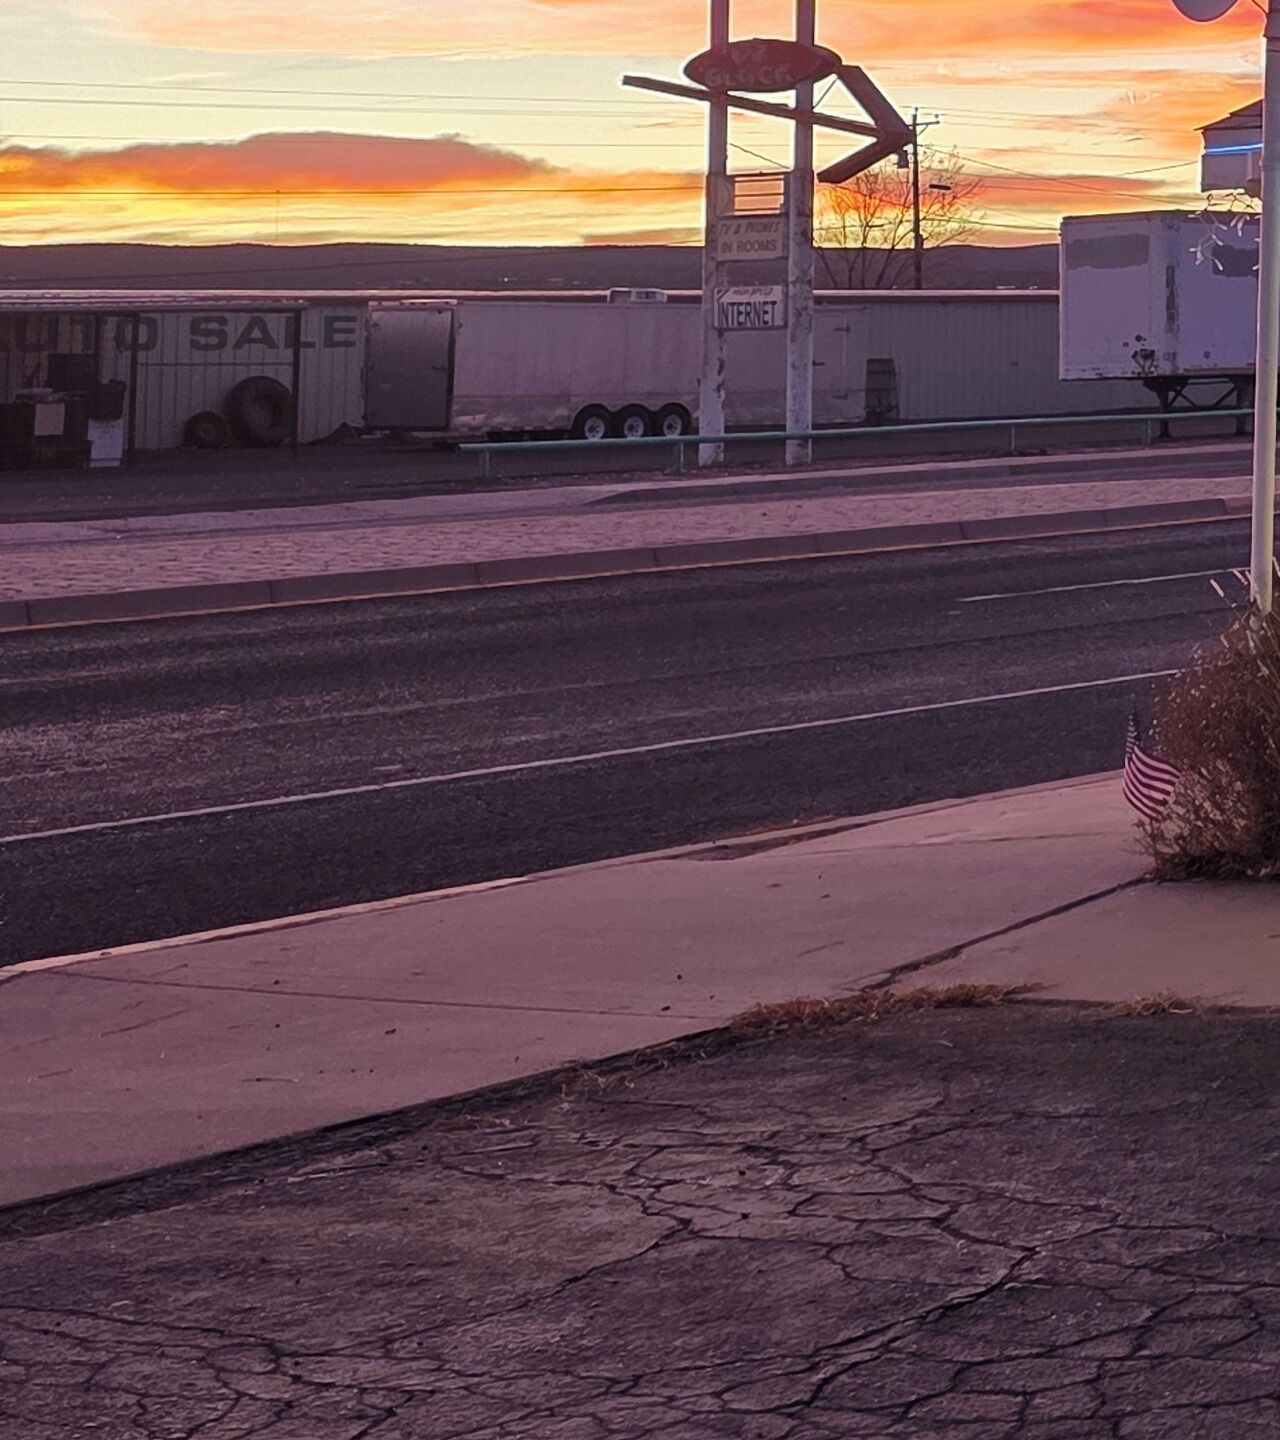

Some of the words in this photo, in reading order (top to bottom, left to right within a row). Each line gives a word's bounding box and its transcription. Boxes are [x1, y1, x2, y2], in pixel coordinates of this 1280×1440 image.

[721, 241, 732, 254] IN
[737, 239, 777, 253] ROOMS
[717, 300, 778, 328] INTERNET
[189, 315, 358, 352] SALE
